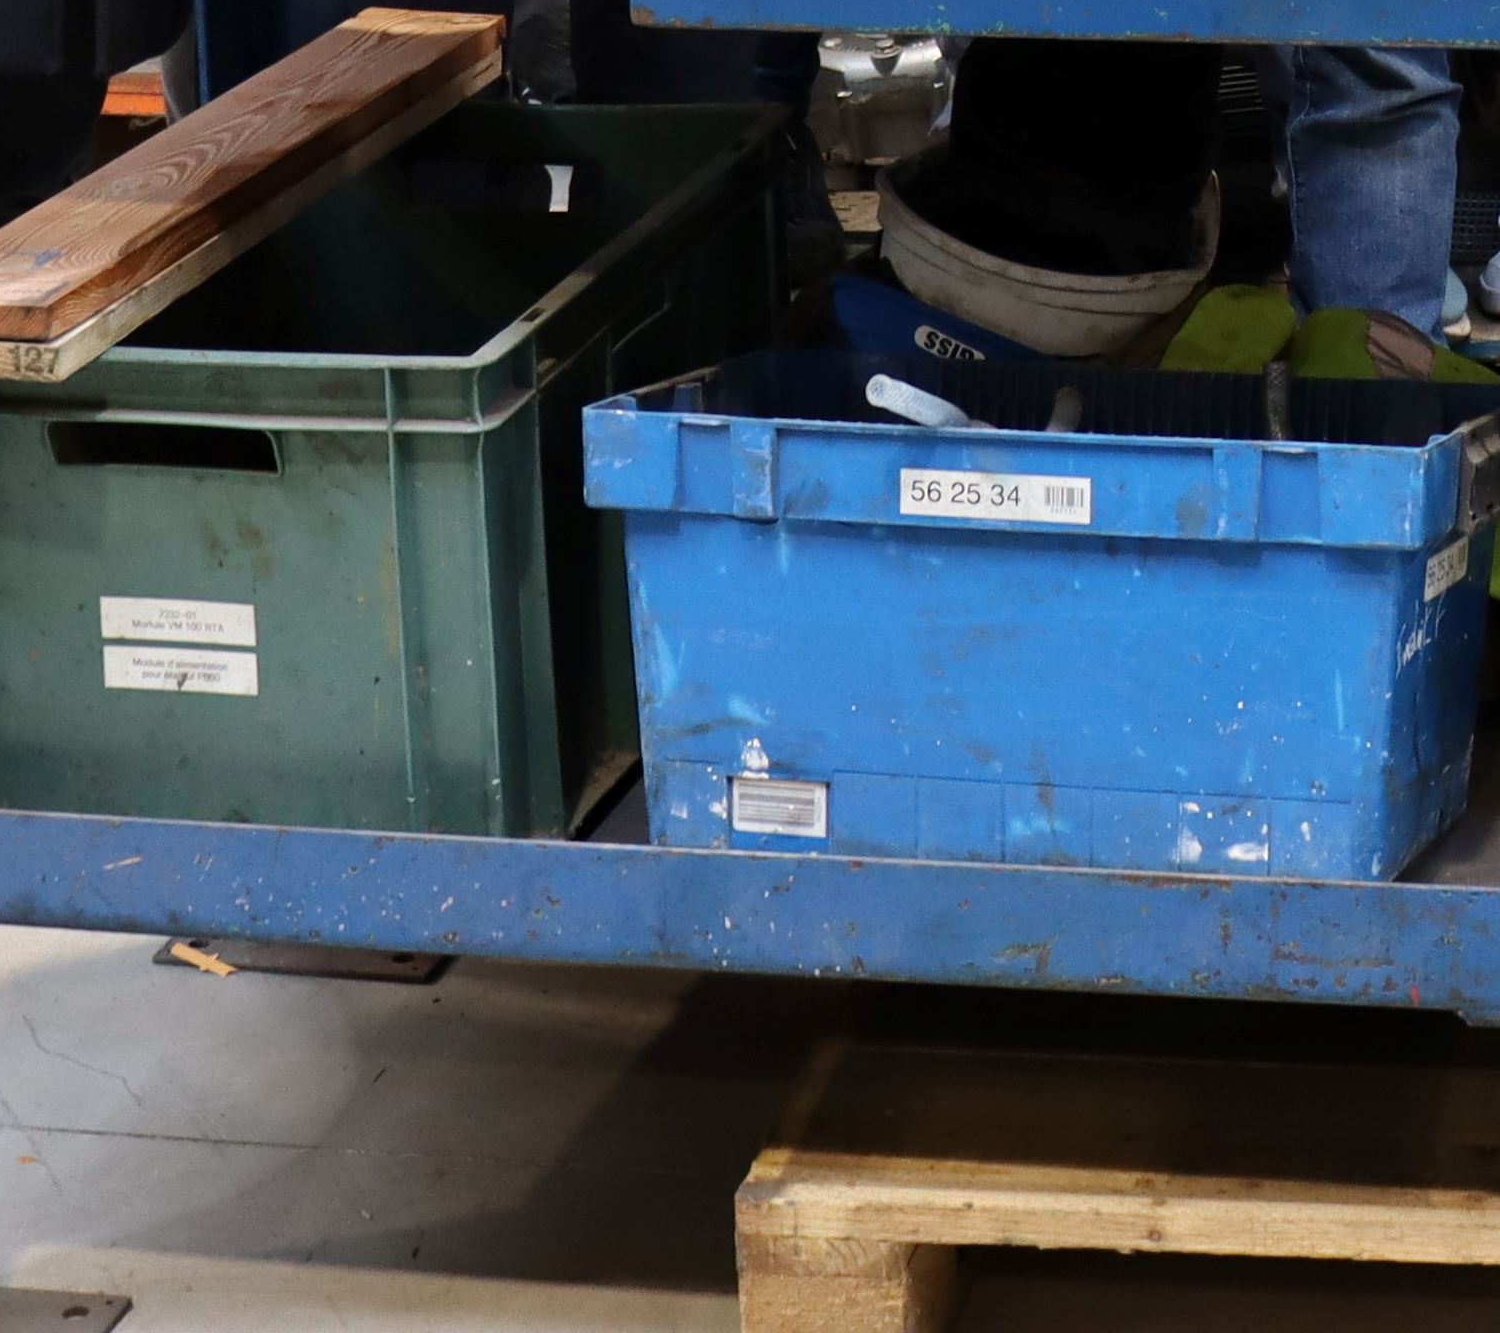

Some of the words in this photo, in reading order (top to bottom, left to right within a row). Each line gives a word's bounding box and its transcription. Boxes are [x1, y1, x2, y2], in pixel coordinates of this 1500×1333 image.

[910, 480, 942, 502] 56
[951, 482, 981, 504] 25
[990, 484, 1021, 506] 34
